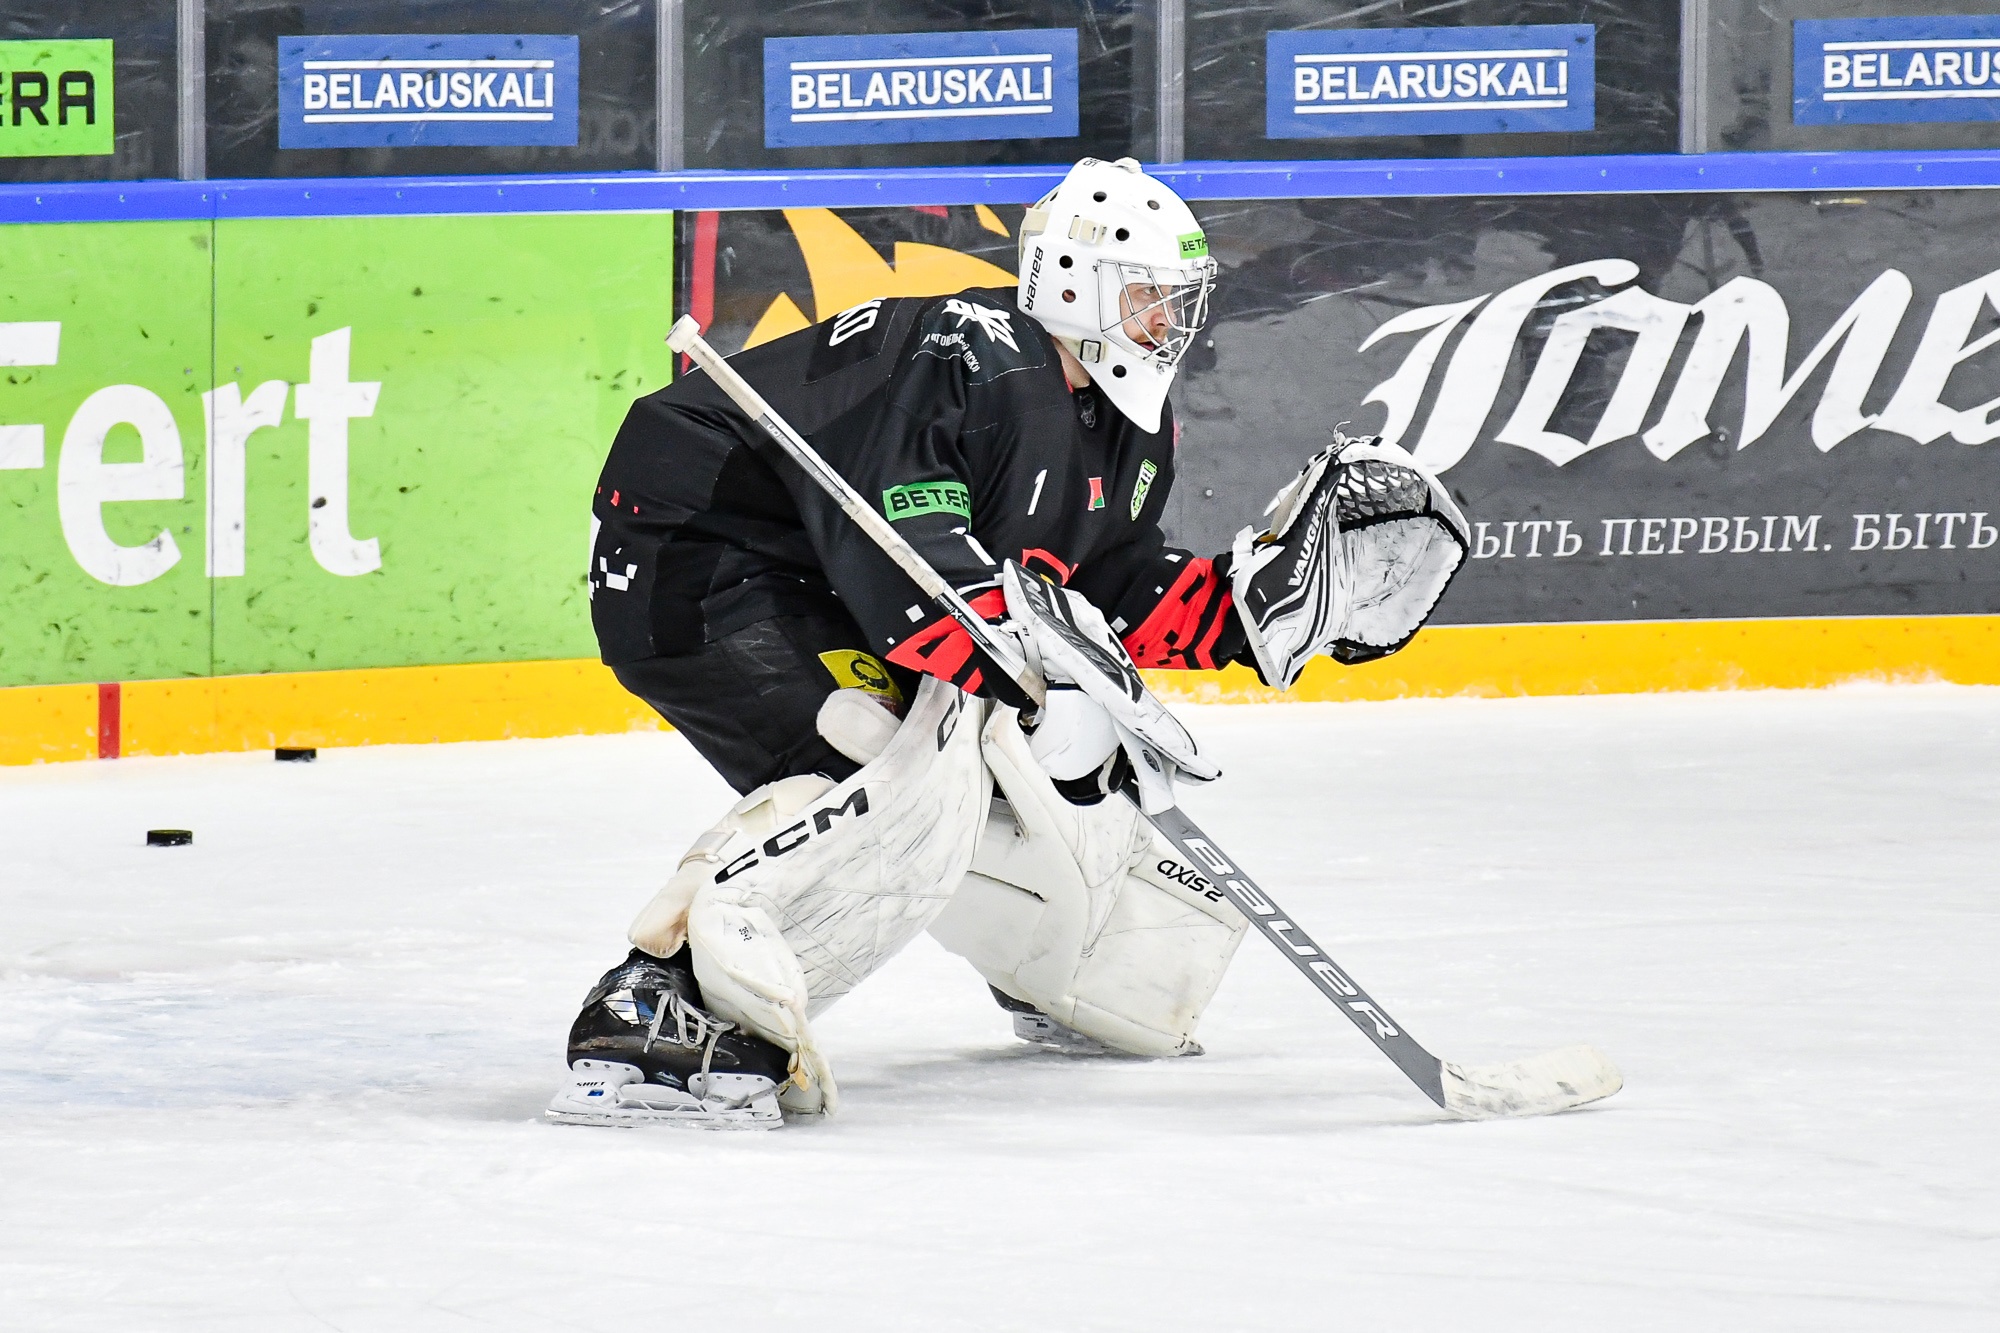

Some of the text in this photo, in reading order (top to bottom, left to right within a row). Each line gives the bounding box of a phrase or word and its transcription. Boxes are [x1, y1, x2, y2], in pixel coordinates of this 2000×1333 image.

[0, 70, 95, 126] RA
[303, 71, 554, 110] BELARUSKALI
[790, 66, 1052, 110] BELARUSKALI
[1294, 61, 1568, 102] BELARUSKALI
[1024, 246, 1044, 311] BAUER
[1357, 258, 2000, 476] Гоме
[1027, 469, 1048, 516] 1
[1468, 511, 1999, 559] ЫТЬ ПЕРВЫМ. БЫТЬ
[714, 787, 870, 885] CCM
[1181, 837, 1400, 1041] BAUER
